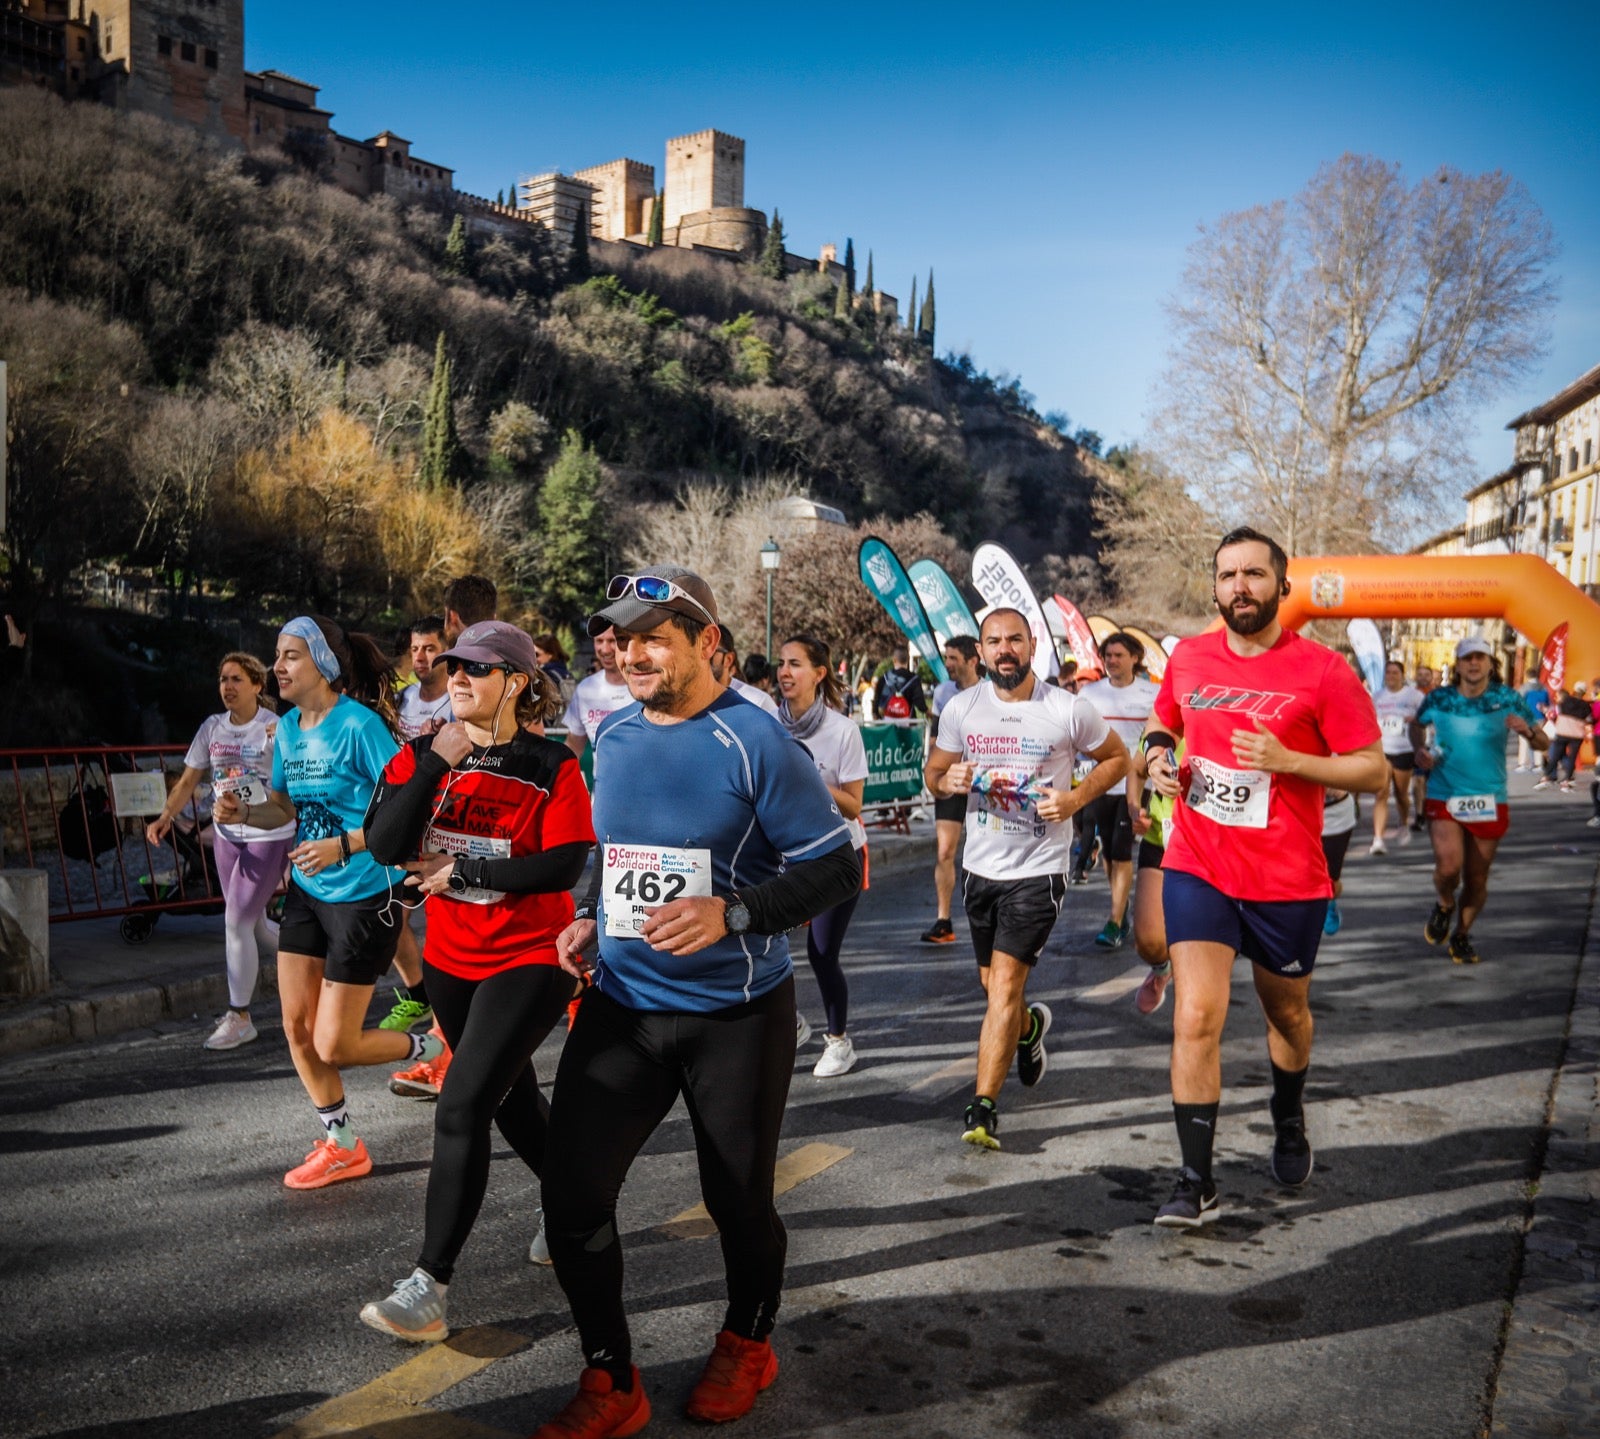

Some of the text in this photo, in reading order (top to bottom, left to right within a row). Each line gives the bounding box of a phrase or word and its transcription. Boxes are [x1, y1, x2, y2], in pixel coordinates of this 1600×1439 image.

[966, 734, 1018, 754] 9 Carrera
[976, 744, 1021, 755] Solidaria
[1203, 774, 1251, 804] 329
[471, 804, 501, 820] AVE
[1458, 799, 1486, 812] 260
[430, 830, 467, 846] Carrera
[607, 847, 658, 868] 9 Carrera
[661, 852, 677, 860] Ave
[616, 858, 661, 872] Solidaria
[660, 865, 696, 874] Granada
[614, 869, 687, 904] 462
